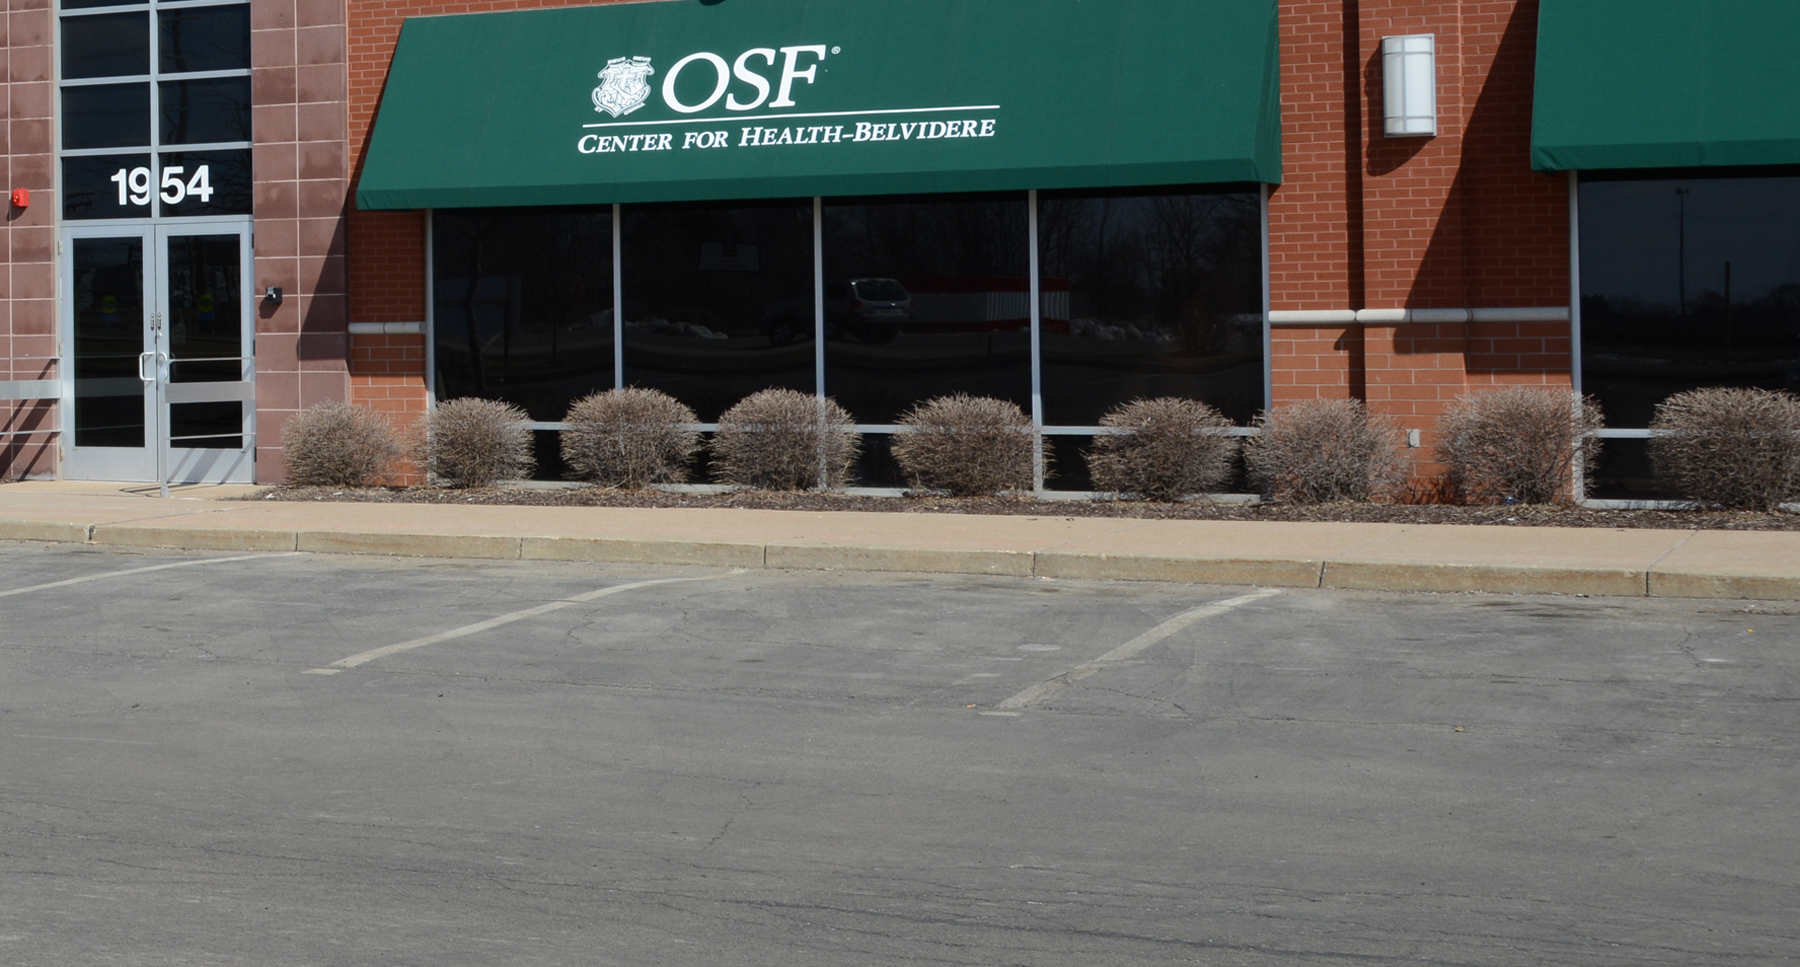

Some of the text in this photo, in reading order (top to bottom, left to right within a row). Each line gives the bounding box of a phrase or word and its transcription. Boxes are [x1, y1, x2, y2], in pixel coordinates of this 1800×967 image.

[662, 44, 827, 114] OSF
[577, 119, 996, 154] CENTER FOR HEALTH-BELVIDERE
[110, 164, 214, 206] 1954
